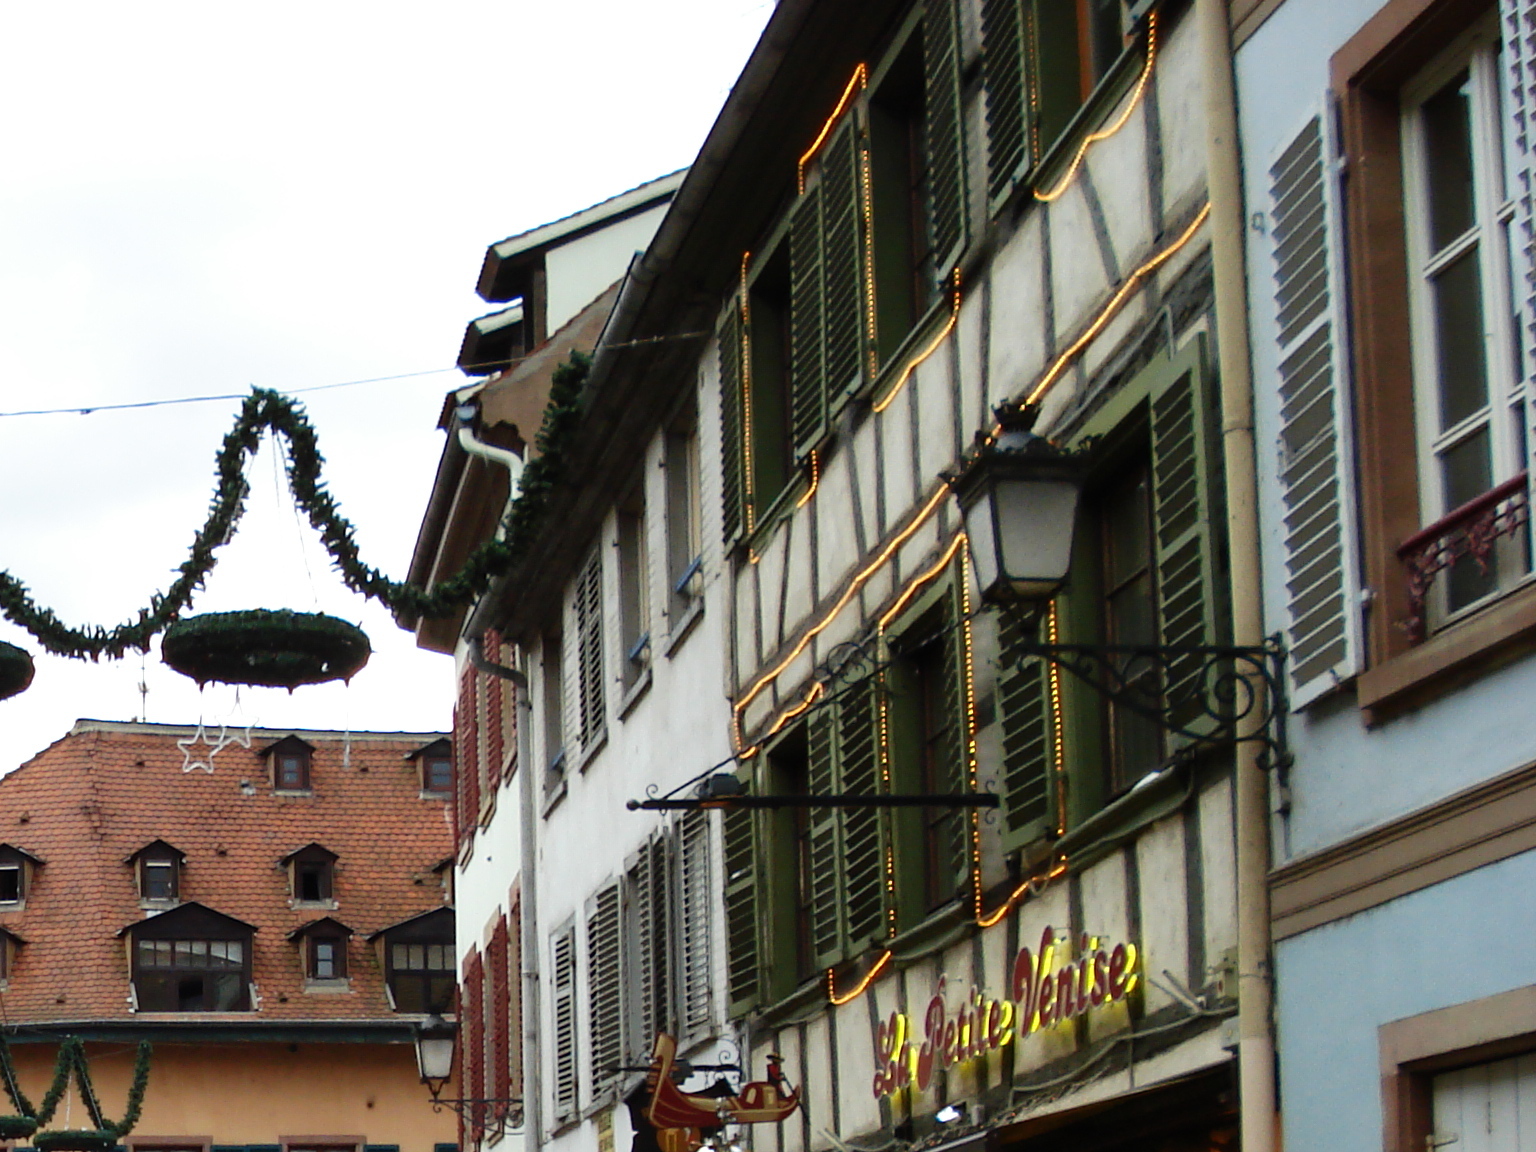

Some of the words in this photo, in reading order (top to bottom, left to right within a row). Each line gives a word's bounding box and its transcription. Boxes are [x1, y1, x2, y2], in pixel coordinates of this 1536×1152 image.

[872, 1010, 918, 1101] La
[917, 972, 1015, 1093] Petite
[1012, 924, 1139, 1040] Venise
